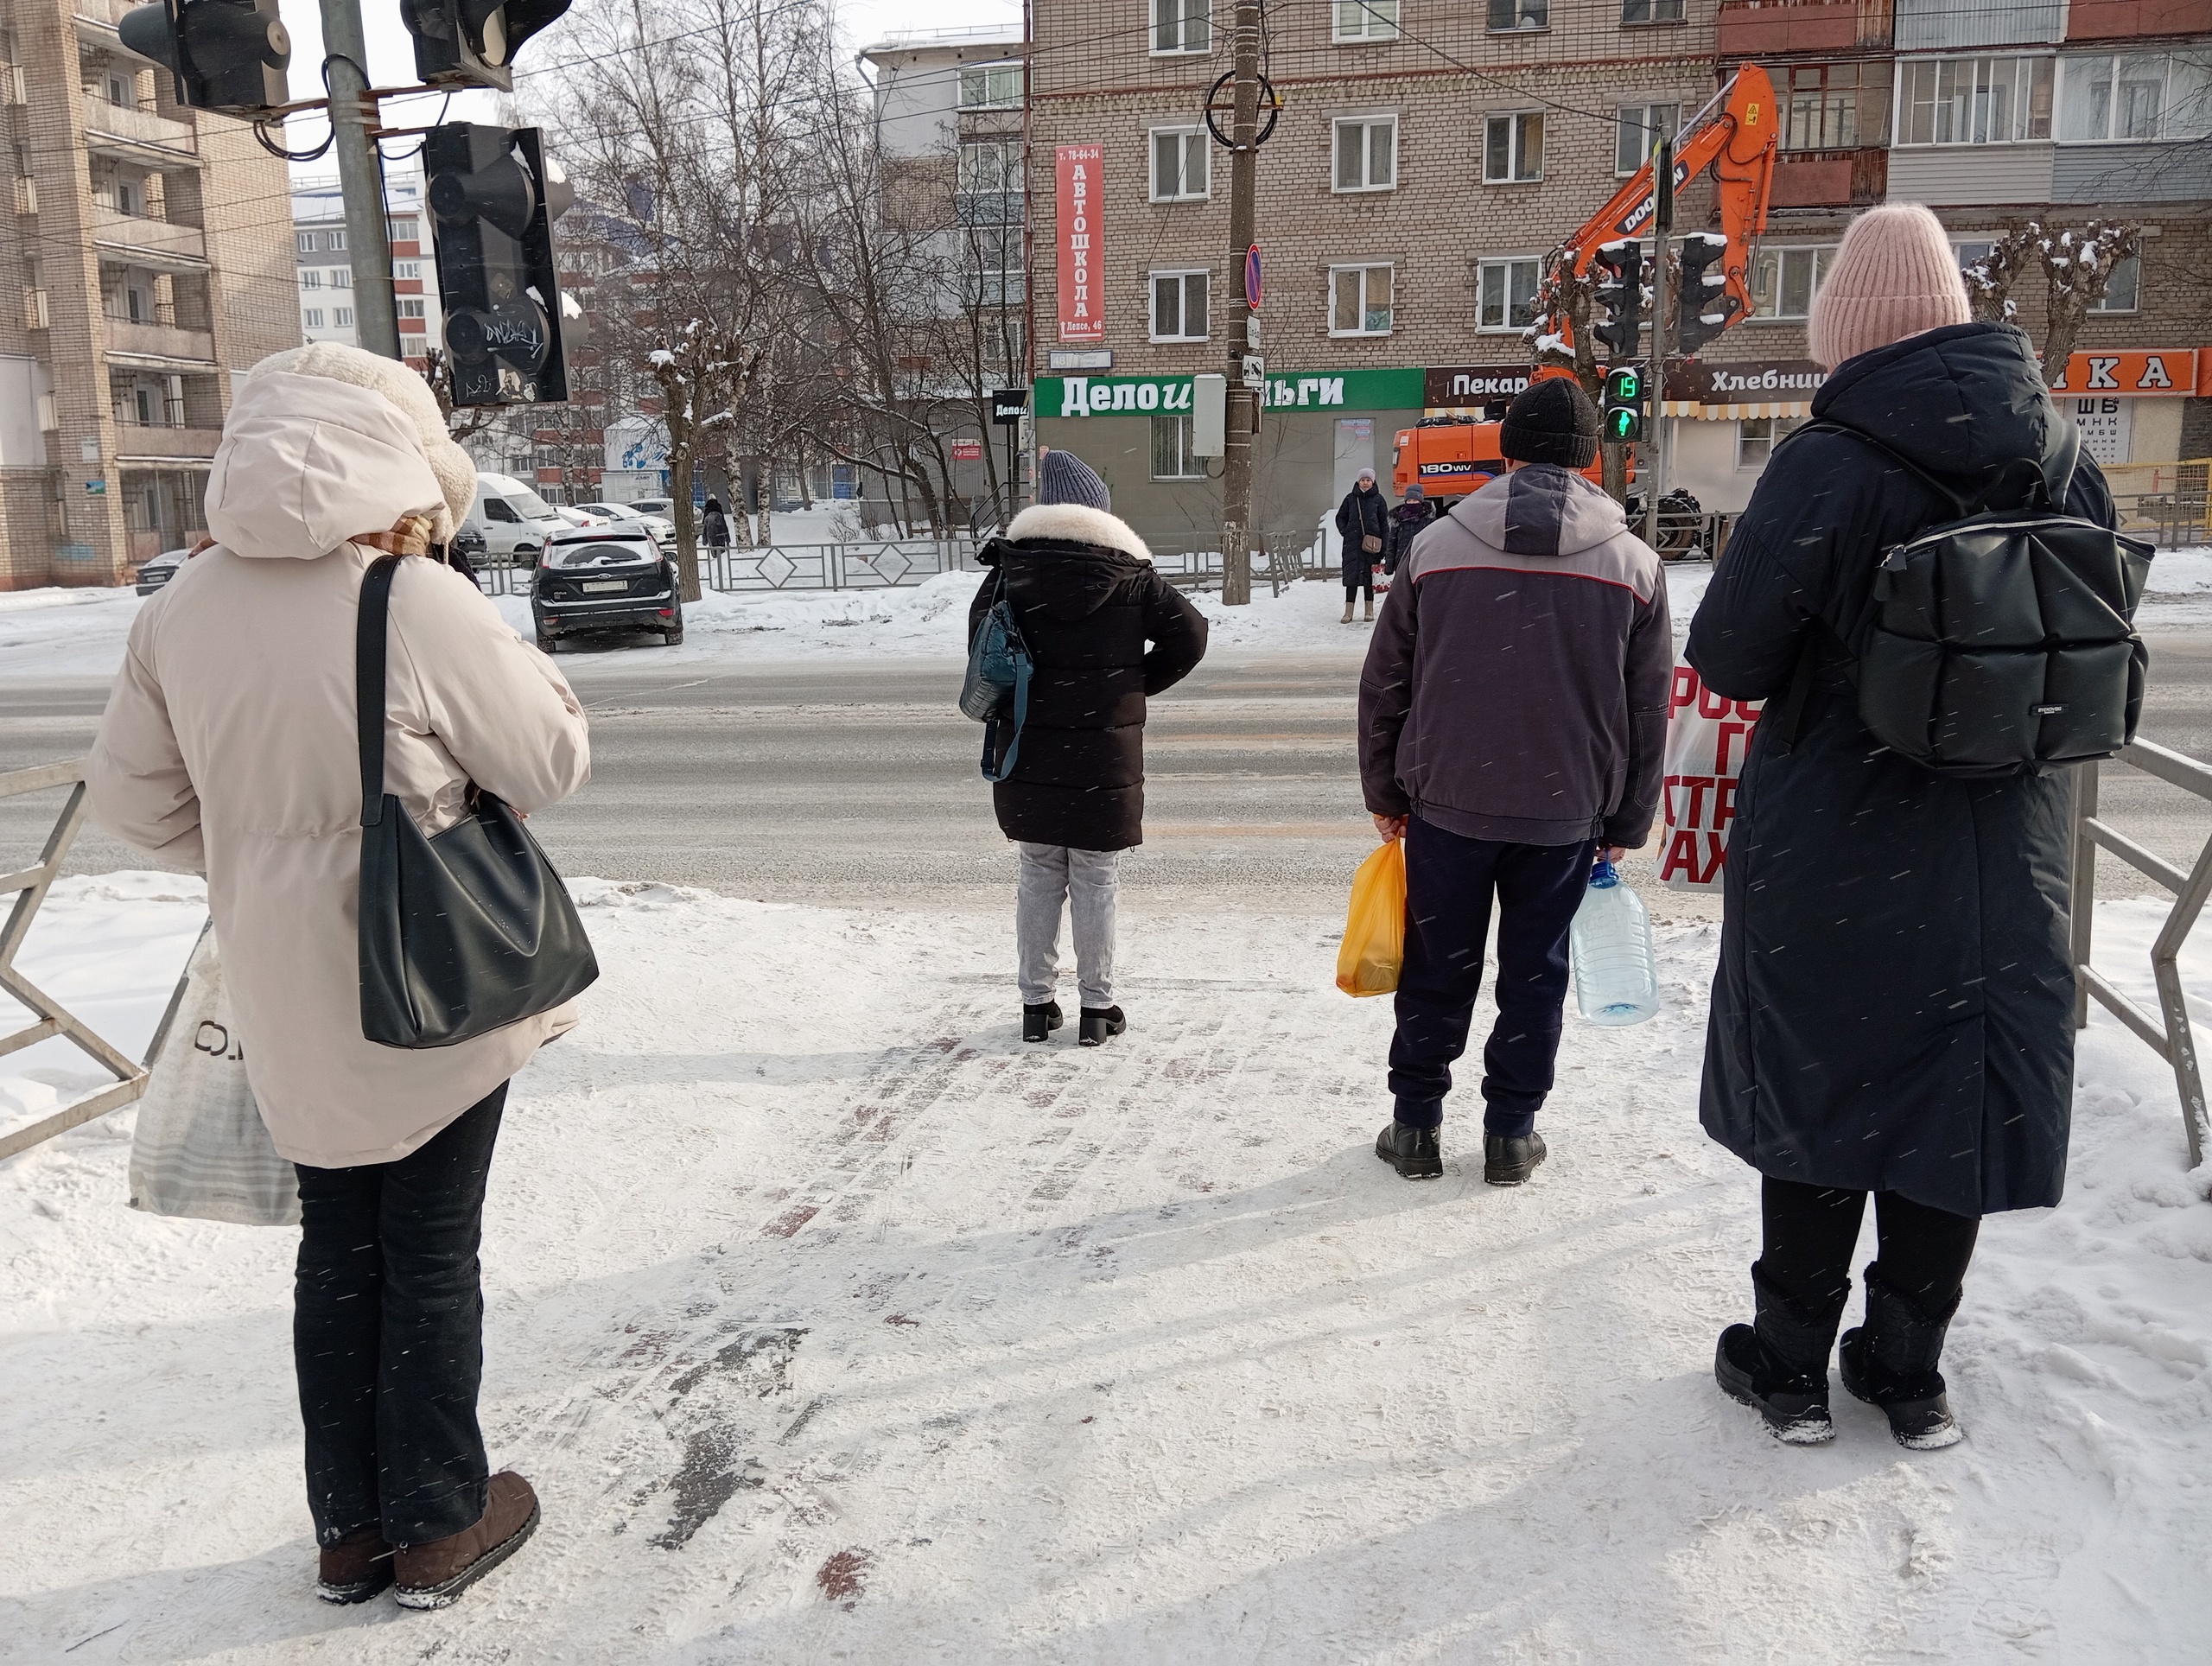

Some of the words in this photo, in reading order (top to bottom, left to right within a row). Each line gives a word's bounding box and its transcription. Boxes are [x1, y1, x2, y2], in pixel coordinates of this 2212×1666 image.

[1068, 149, 1099, 161] 78-64-34
[1624, 167, 1685, 232] DOON
[1071, 164, 1090, 318] АВТОШКОЛА
[1066, 321, 1091, 333] Лепсе,
[1093, 320, 1102, 330] 46
[1620, 377, 1635, 397] 19
